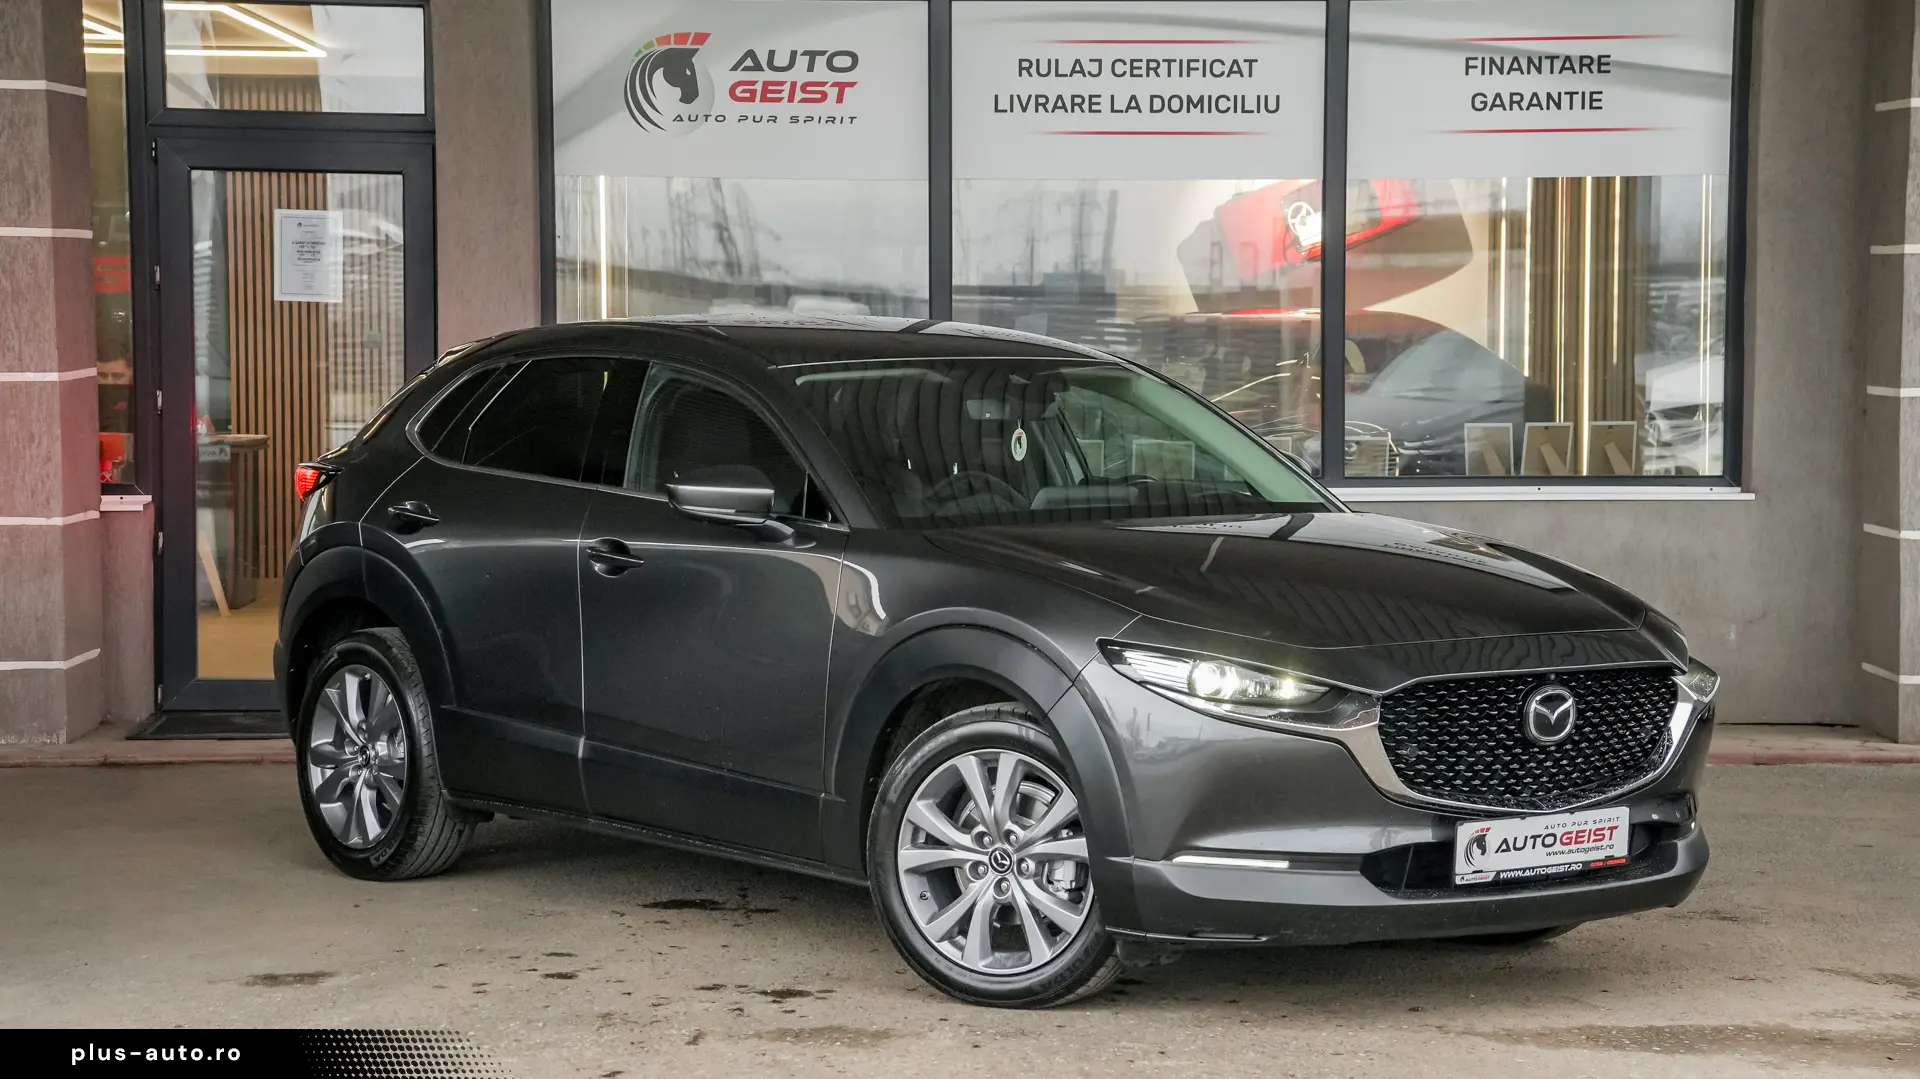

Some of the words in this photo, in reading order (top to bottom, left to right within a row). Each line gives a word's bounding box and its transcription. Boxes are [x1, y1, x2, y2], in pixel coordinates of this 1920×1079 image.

[729, 49, 859, 73] AUTO
[1018, 58, 1103, 78] RULAJ
[1110, 58, 1259, 78] CERTIFICAT
[1465, 54, 1612, 76] FINANTARE
[729, 80, 858, 104] GEIST
[1470, 90, 1604, 112] GARANTIE
[994, 94, 1102, 114] LIVRARE
[1110, 94, 1143, 113] LA
[1149, 94, 1281, 114] DOMICILIU
[672, 114, 727, 124] AUTO
[737, 114, 778, 124] PUR
[789, 114, 858, 125] SPIRIT
[1544, 822, 1567, 830] AUTO
[1592, 816, 1620, 825] SPIRIT
[1545, 844, 1615, 857] www.autogeist.ro
[1500, 863, 1583, 879] WWW.AUTOGEIST.RO
